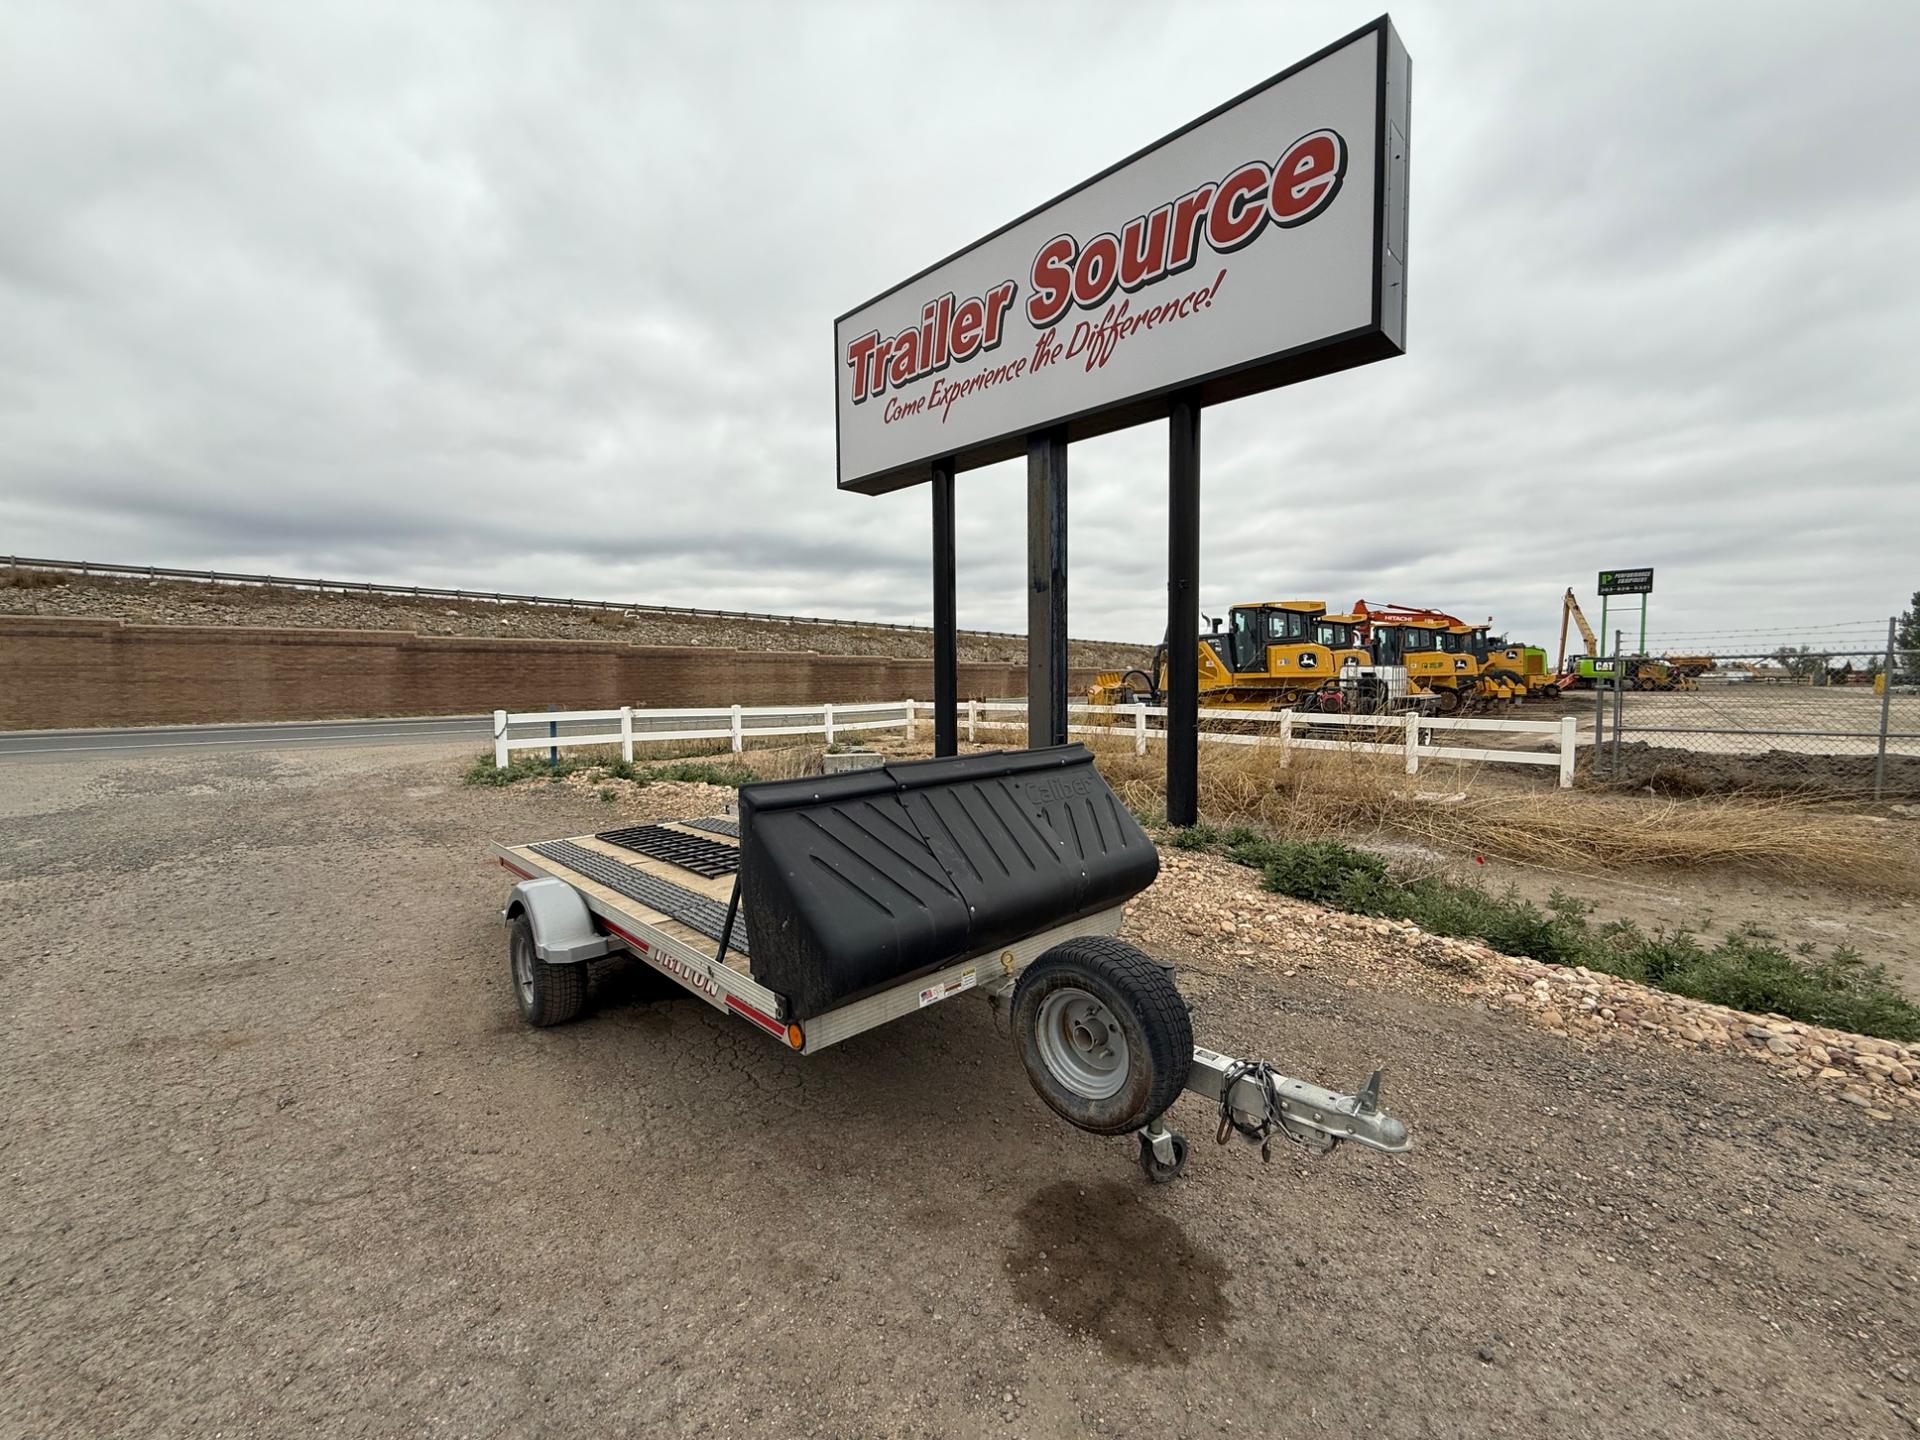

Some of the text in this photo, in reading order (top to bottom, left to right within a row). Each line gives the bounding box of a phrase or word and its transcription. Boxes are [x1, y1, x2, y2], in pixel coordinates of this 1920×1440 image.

[848, 128, 1348, 404] Trailer Source
[884, 269, 1227, 425] Come Experience the Difference!
[1595, 661, 1615, 672] CAT
[653, 947, 719, 998] TRITON
